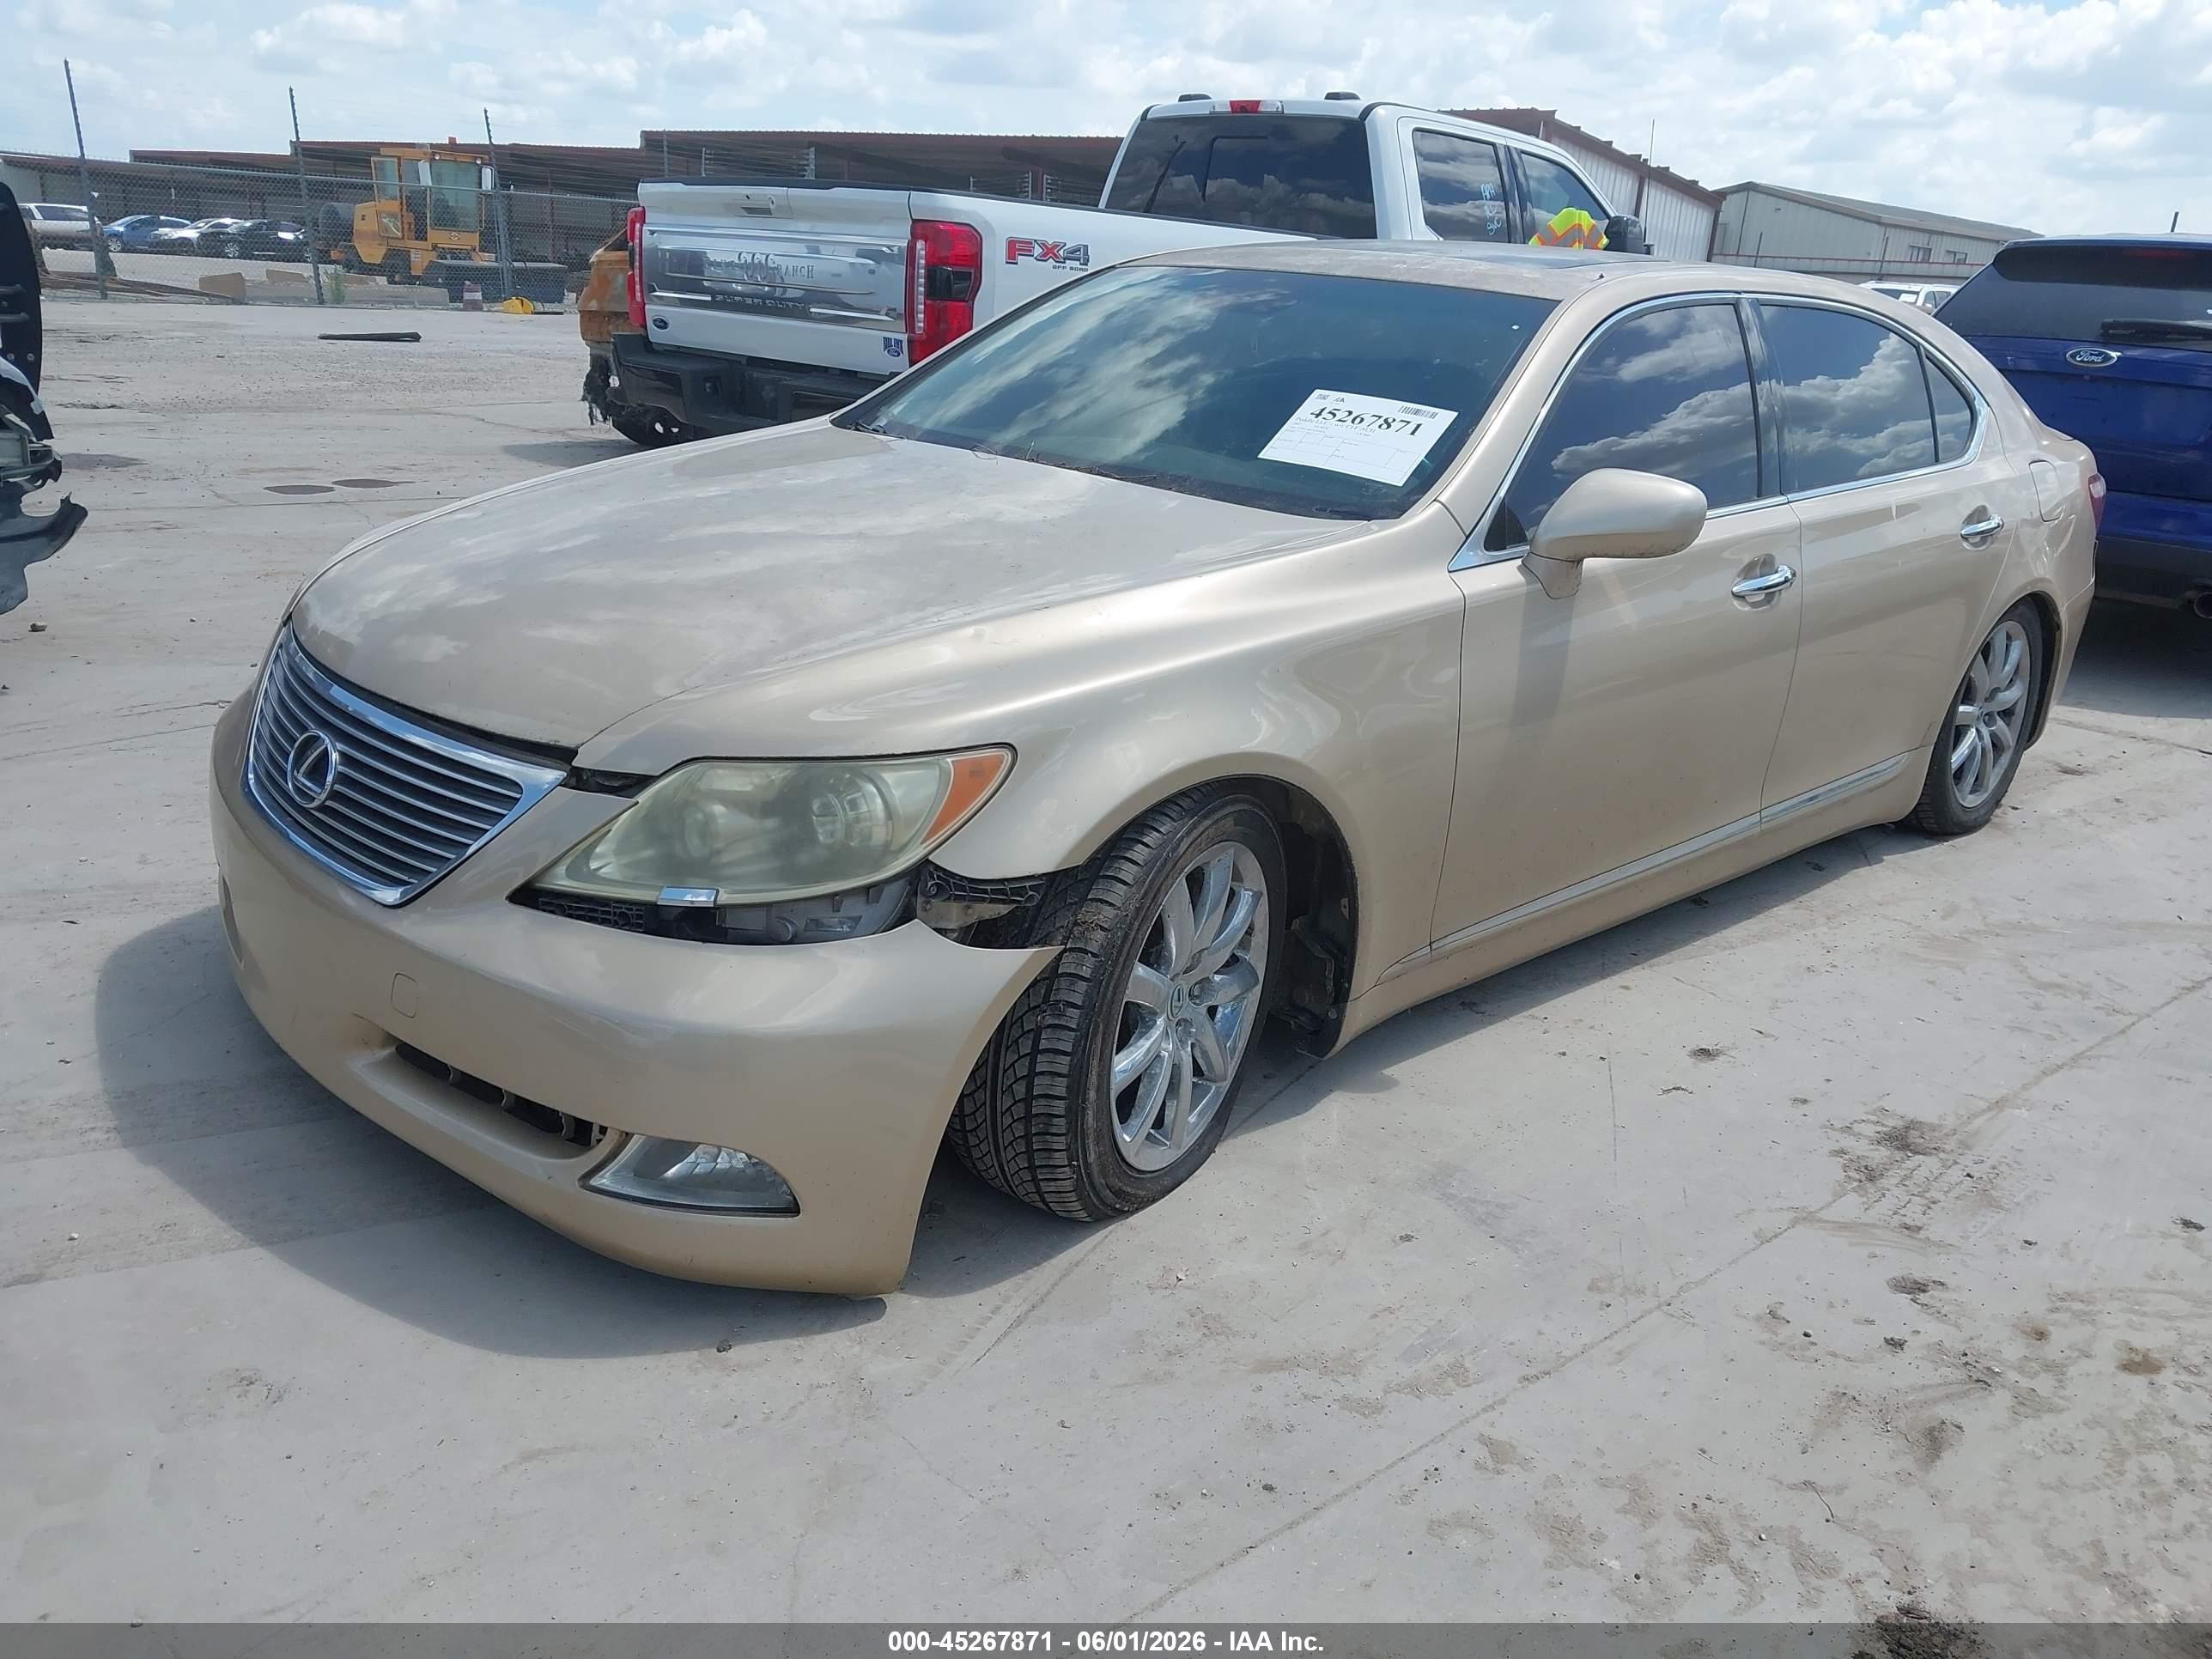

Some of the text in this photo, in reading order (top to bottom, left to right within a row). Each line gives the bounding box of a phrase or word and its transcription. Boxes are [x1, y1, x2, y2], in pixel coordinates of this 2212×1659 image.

[1006, 237, 1090, 266] FX4
[776, 264, 814, 279] RANCH
[2075, 349, 2106, 362] Ford
[1310, 405, 1423, 437] 45267871
